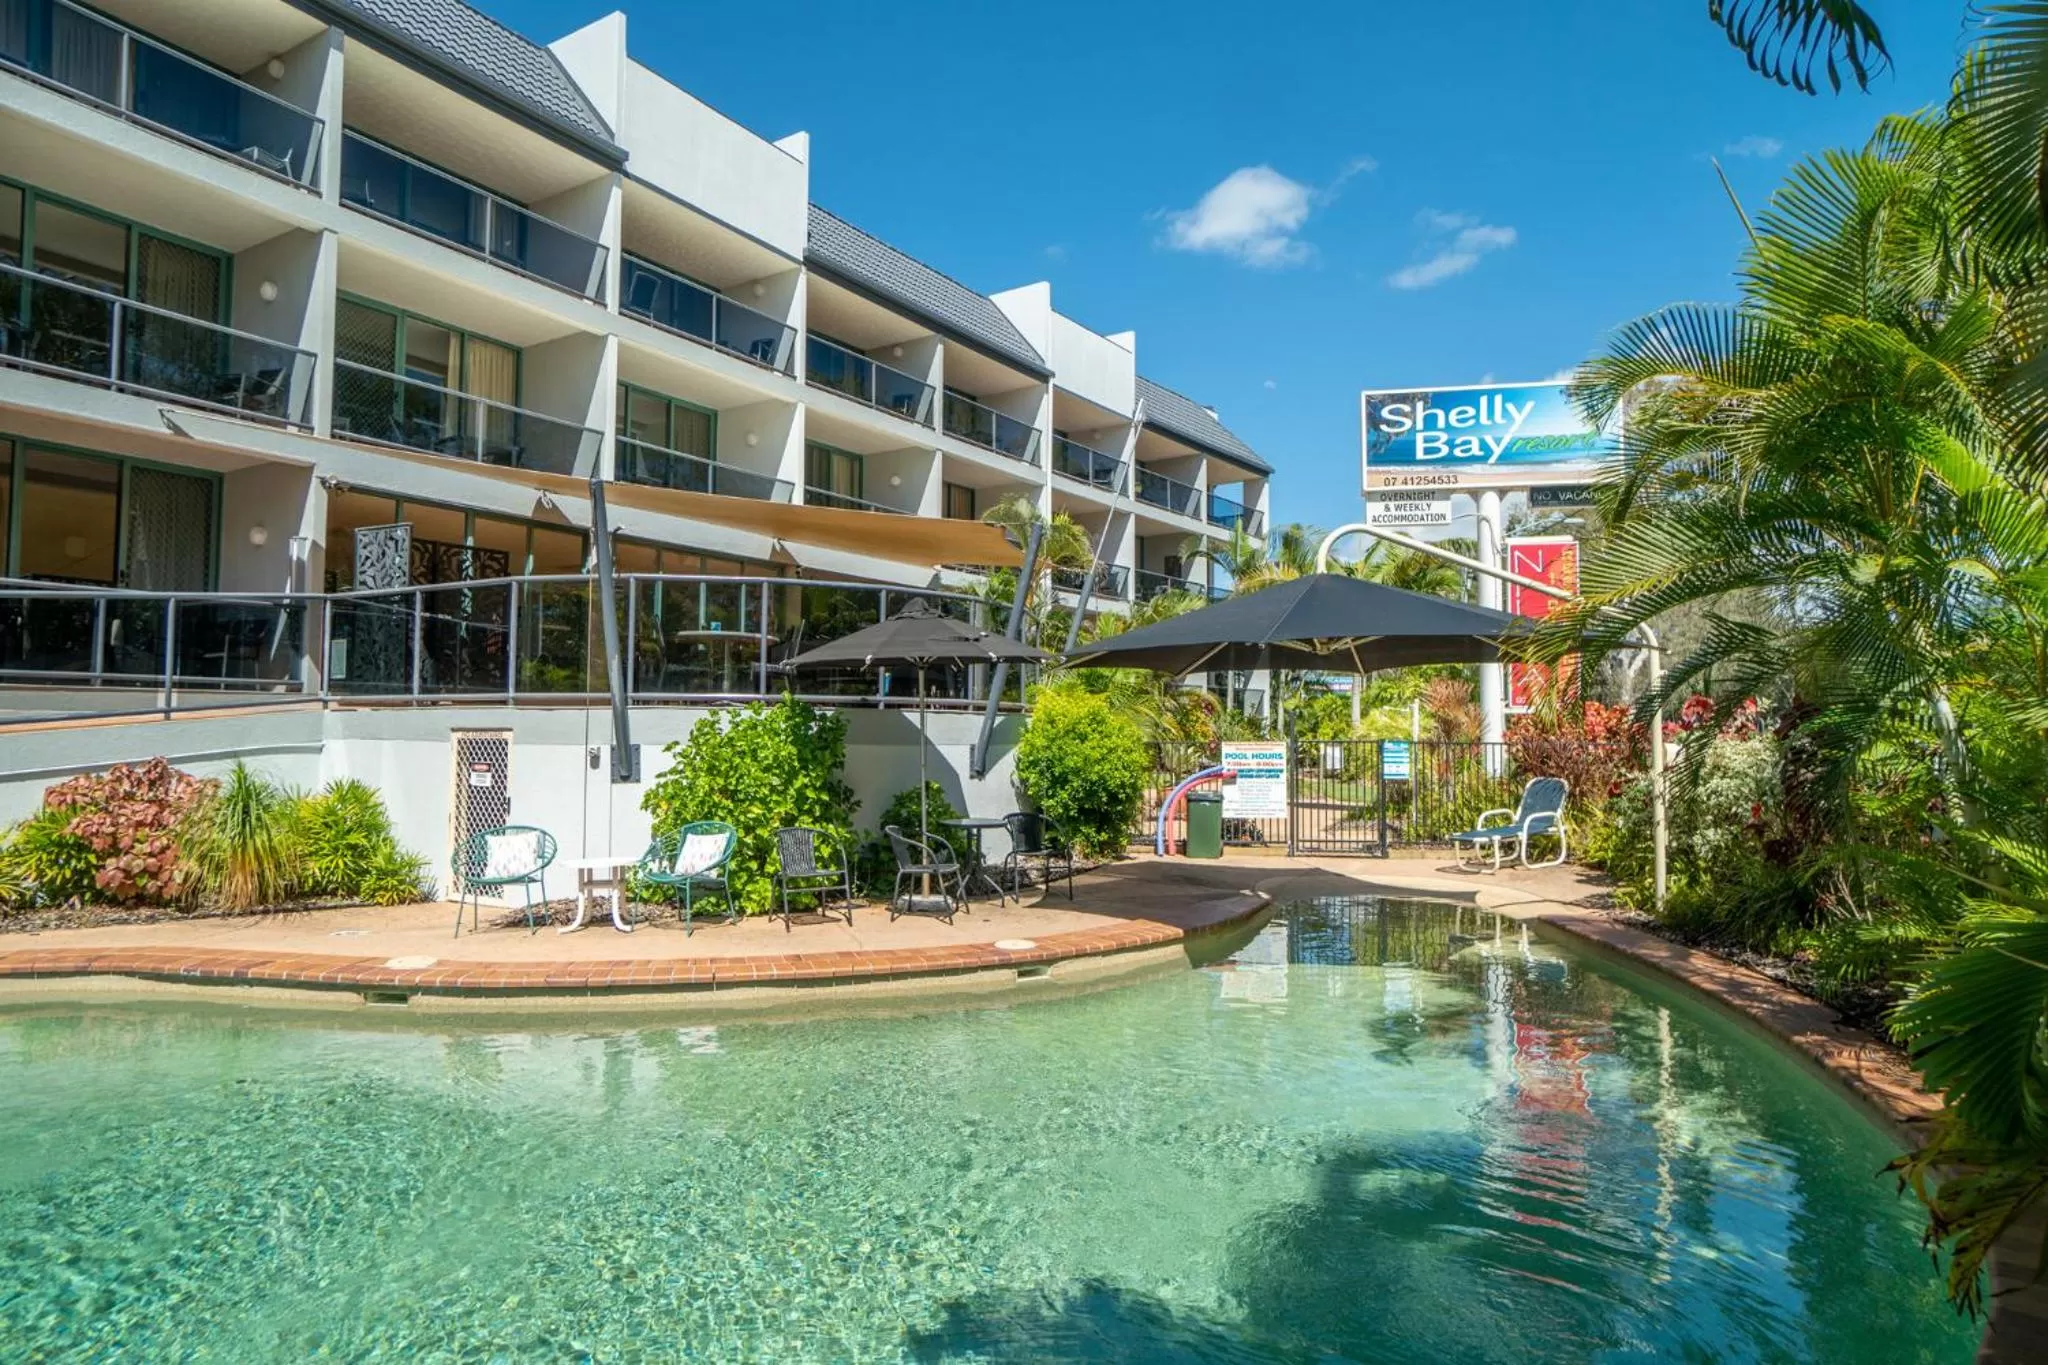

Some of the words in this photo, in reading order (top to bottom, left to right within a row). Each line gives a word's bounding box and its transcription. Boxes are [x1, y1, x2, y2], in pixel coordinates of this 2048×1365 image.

[1379, 394, 1536, 434] Shelly
[1415, 430, 1513, 463] Bay
[1384, 477, 1397, 486] 07
[1401, 475, 1459, 486] 41254533
[1379, 490, 1437, 502] OVERNIGHT
[1532, 490, 1551, 502] NO
[1384, 503, 1392, 512] &
[1394, 502, 1432, 512] WEEKLY
[1371, 513, 1447, 524] ACCOMMODATION
[1225, 752, 1249, 760] POOL
[1251, 752, 1284, 760] HOURS
